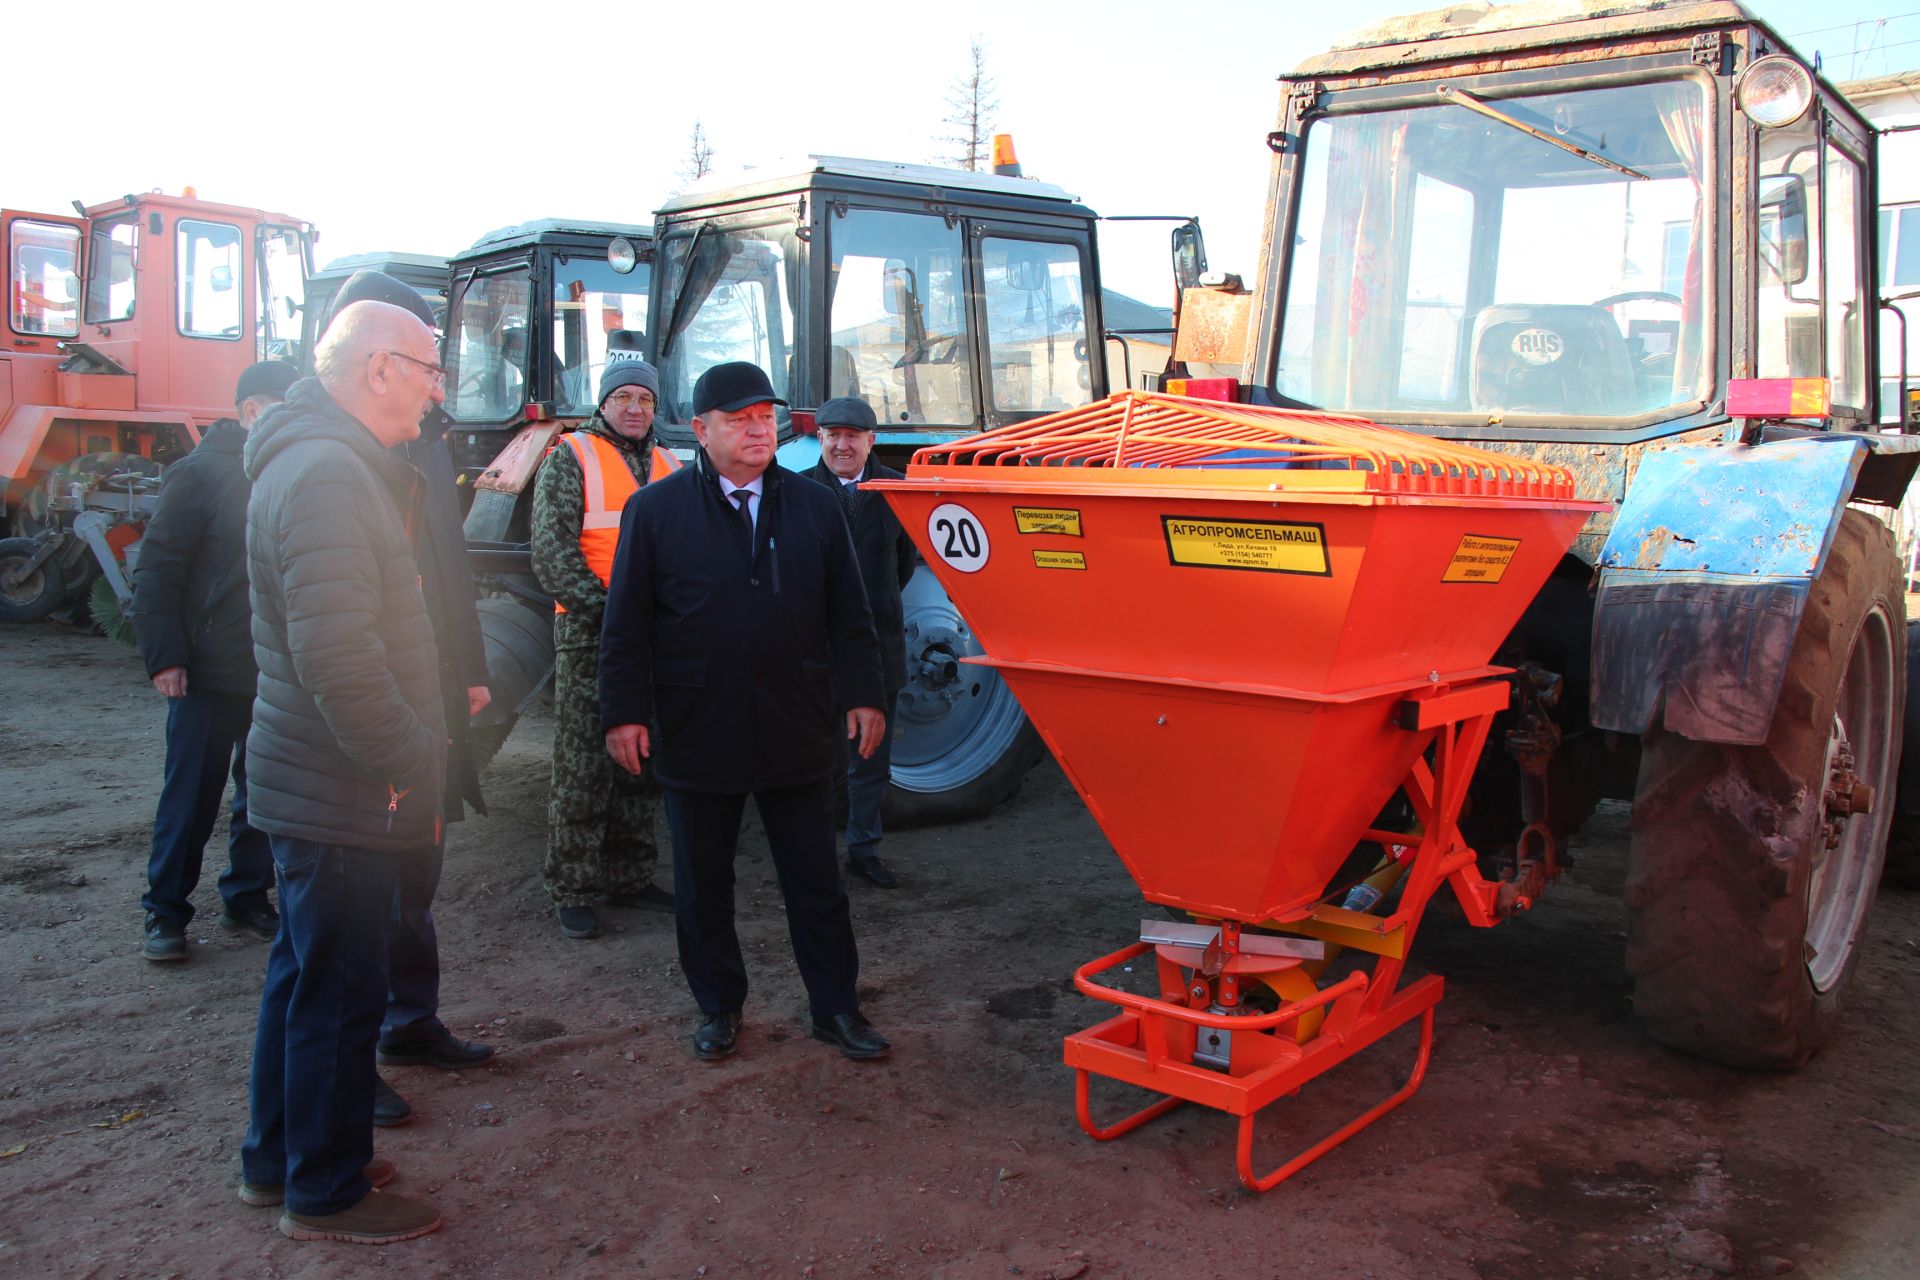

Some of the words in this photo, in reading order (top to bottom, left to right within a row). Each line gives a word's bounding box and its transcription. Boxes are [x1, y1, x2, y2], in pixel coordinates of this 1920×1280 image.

[1519, 335, 1559, 352] RUS
[1017, 510, 1053, 520] Перевозка
[1055, 513, 1077, 521] людей
[937, 518, 980, 558] 20
[1173, 524, 1317, 543] АГРОПРОМСЕЛЬМАШ
[1035, 555, 1058, 563] Опасная
[1235, 551, 1250, 559] (154)
[1227, 558, 1268, 567] www.apsm.by
